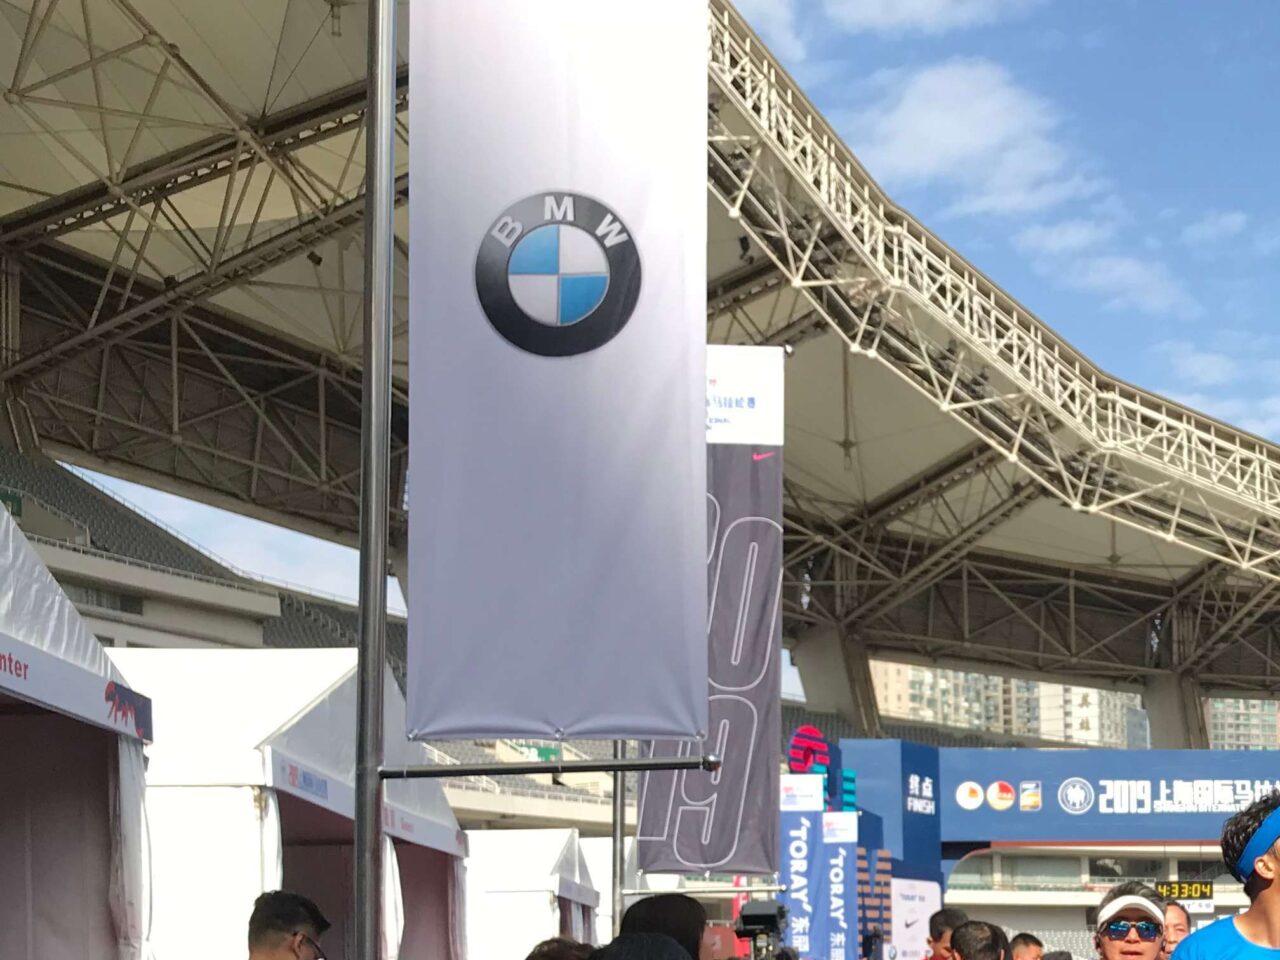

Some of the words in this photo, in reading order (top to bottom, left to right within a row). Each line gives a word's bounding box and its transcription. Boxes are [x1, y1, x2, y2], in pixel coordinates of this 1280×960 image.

[491, 195, 629, 249] BMW
[907, 796, 935, 815] FINISH
[1099, 780, 1151, 813] 2019
[1158, 883, 1211, 898] 4:33:04
